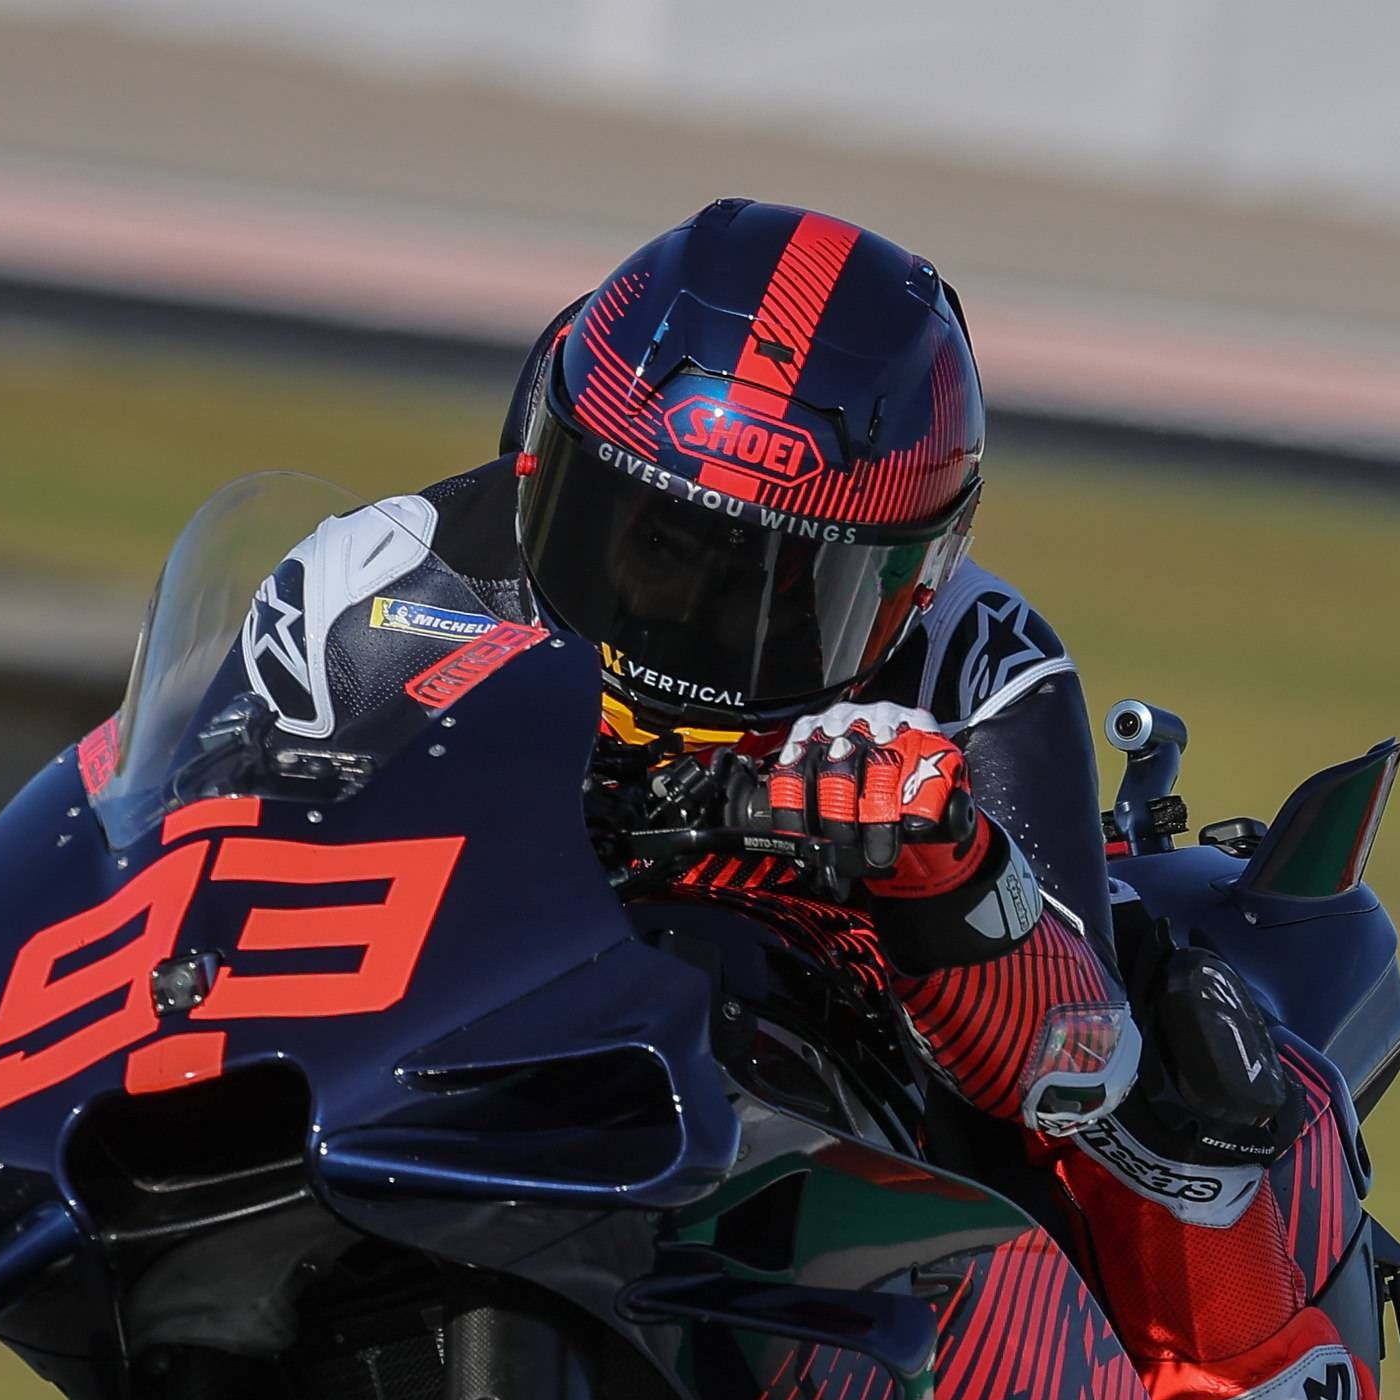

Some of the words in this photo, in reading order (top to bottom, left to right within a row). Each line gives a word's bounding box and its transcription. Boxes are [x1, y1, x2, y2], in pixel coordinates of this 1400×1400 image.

[684, 408, 805, 477] SHOEI
[598, 443, 672, 490] GIVES
[685, 481, 745, 518] YOU
[759, 508, 857, 544] WINGS
[628, 660, 745, 707] VERTICAL
[1078, 1118, 1223, 1202] inestars
